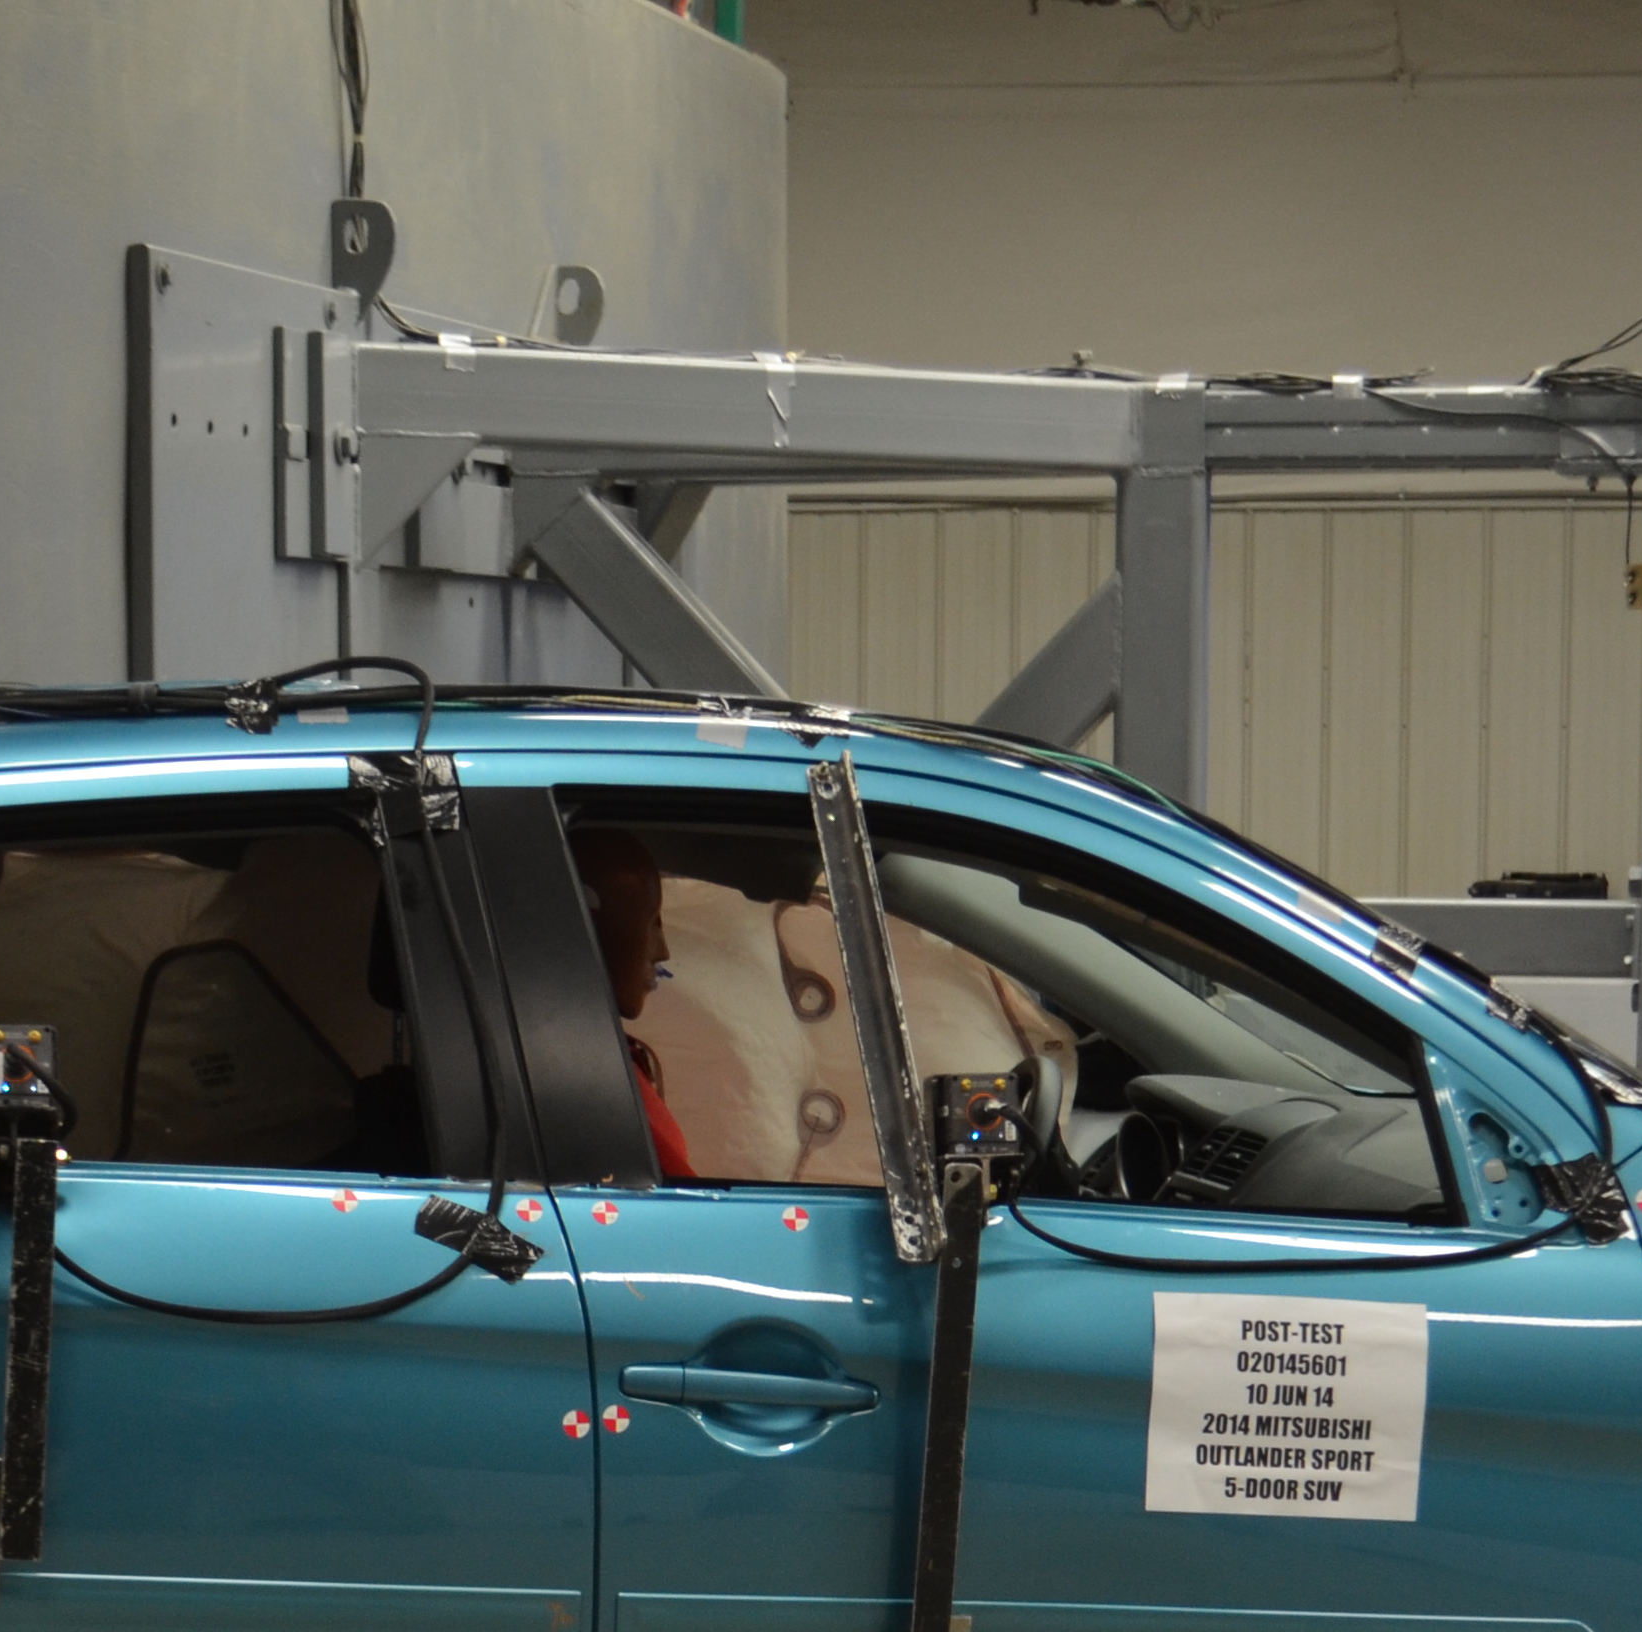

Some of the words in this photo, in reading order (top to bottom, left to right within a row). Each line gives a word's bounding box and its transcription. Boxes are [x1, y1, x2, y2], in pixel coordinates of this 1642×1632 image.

[1241, 1319, 1345, 1345] POST-TEST
[1236, 1350, 1347, 1377] 020145601
[1246, 1383, 1269, 1405] 10
[1272, 1384, 1308, 1407] JUN
[1313, 1386, 1334, 1408] 14
[1202, 1412, 1250, 1436] 2014
[1255, 1415, 1372, 1441] MITSUBISHI
[1195, 1443, 1306, 1469] OUTLANDER
[1311, 1448, 1375, 1472] SPORT
[1224, 1476, 1299, 1501] 5-DOOR
[1303, 1479, 1343, 1502] SUV
